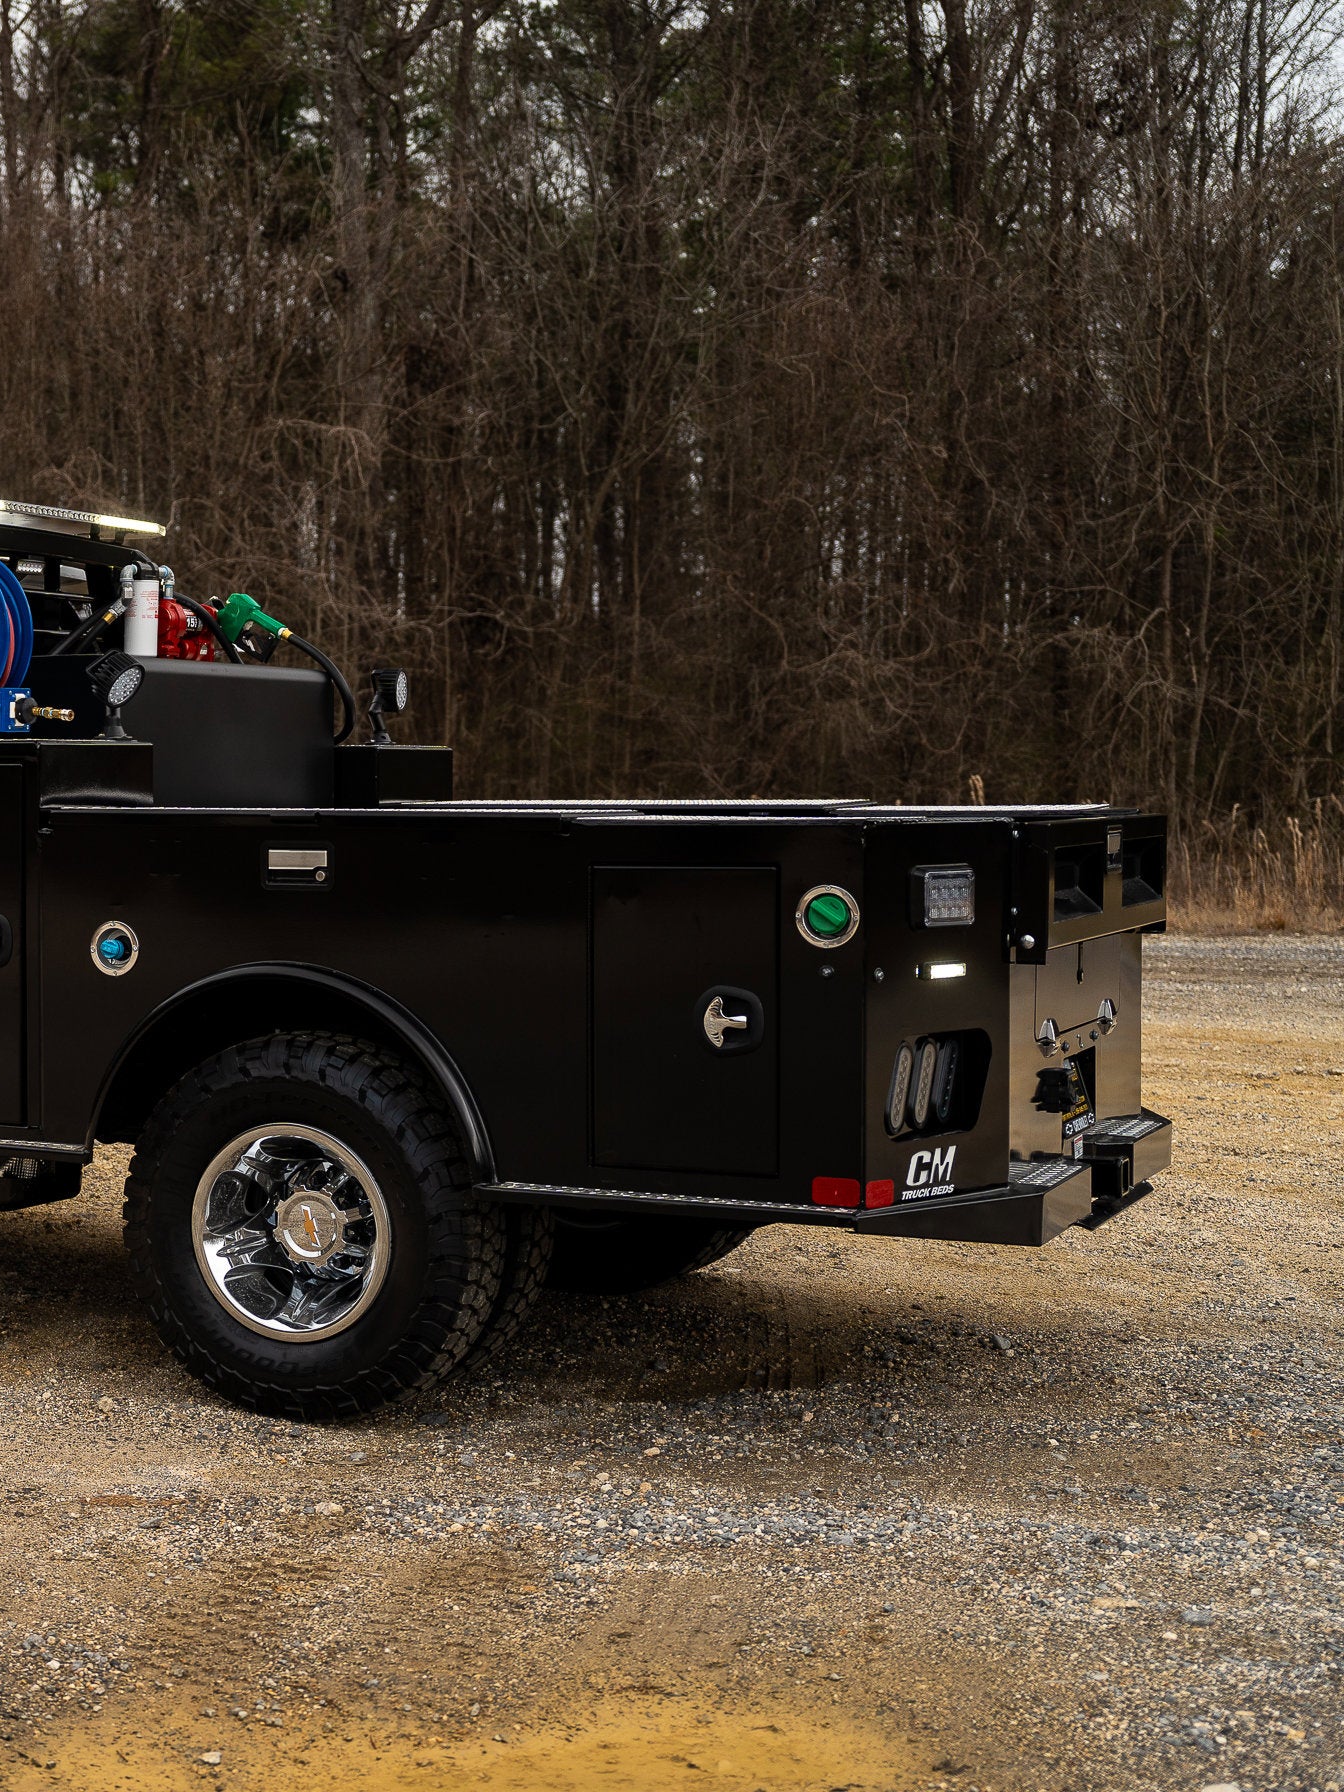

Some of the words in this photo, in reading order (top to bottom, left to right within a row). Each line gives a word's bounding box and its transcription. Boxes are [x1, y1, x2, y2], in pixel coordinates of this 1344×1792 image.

[906, 1145, 956, 1186] CM
[901, 1187, 931, 1200] TRUCK
[930, 1184, 955, 1196] BEDS
